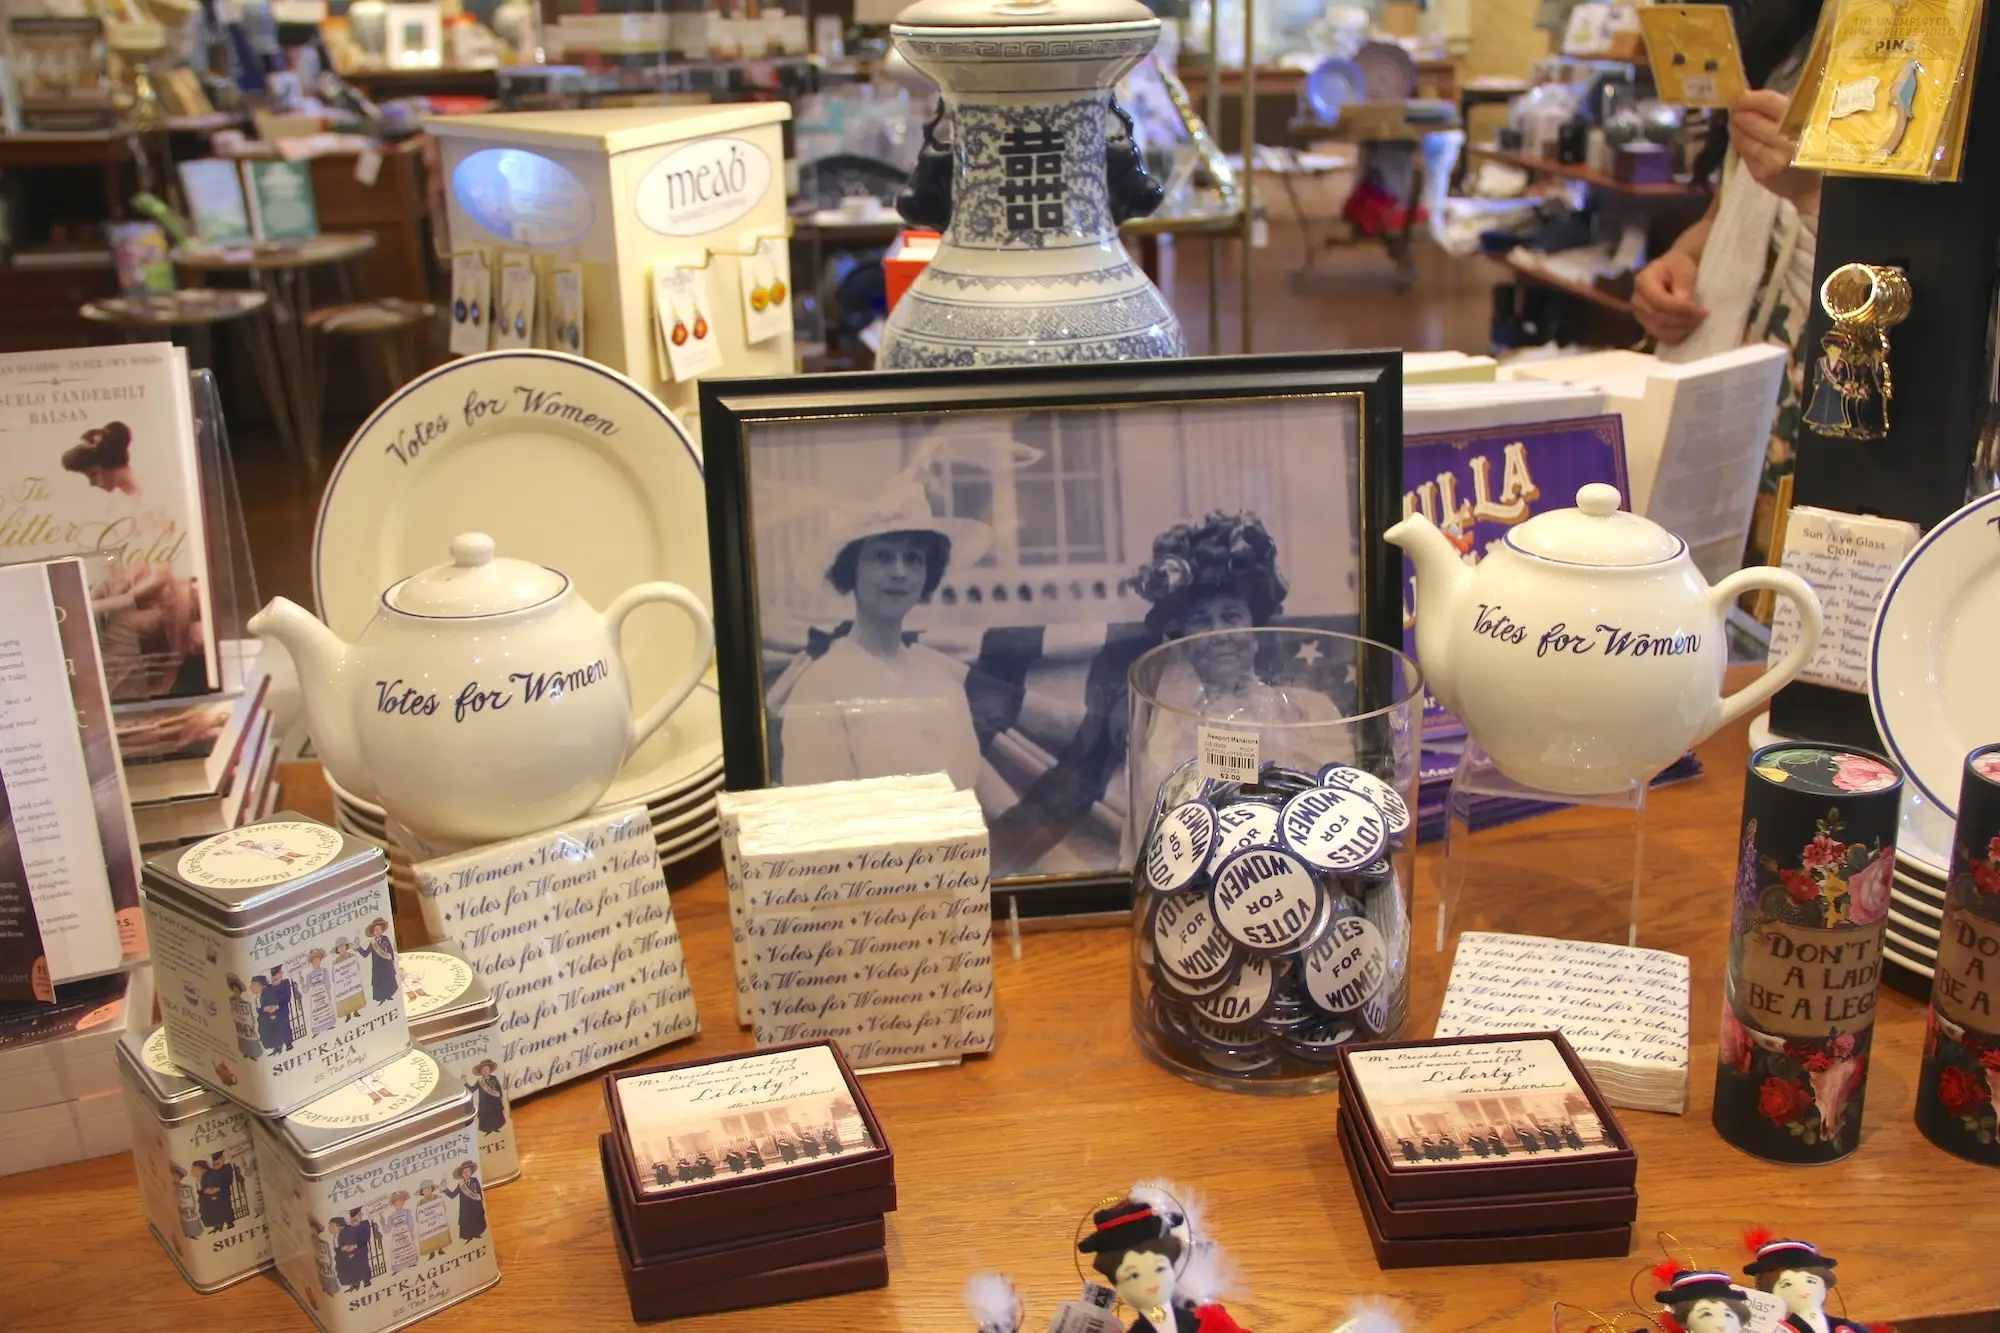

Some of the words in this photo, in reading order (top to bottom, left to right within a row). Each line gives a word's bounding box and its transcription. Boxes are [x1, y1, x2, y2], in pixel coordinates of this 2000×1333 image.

[1874, 39, 1917, 53] PINS
[51, 385, 147, 405] VANDERBILT
[29, 409, 89, 426] BALSAN
[386, 413, 449, 467] Votes
[462, 390, 508, 427] for
[513, 385, 621, 437] Women
[0, 507, 79, 548] litter
[1803, 528, 1824, 541] Sun
[1856, 537, 1887, 551] Glass
[1827, 545, 1859, 559] Cloth
[1473, 603, 1528, 645] Votes
[1537, 623, 1596, 659] for
[1595, 624, 1702, 658] Women
[376, 678, 440, 717] Votes
[453, 682, 514, 723] for
[509, 657, 609, 706] Women
[1207, 733, 1230, 742] Newport
[1220, 773, 1241, 781] $2.00
[1287, 790, 1347, 847] WOMEN
[1380, 785, 1406, 830] OMEN
[1175, 806, 1212, 864] WOMEN
[1320, 814, 1350, 843] FOR
[1327, 815, 1379, 865] VOTES
[304, 849, 331, 867] Tea
[1148, 833, 1175, 888] VOTES
[1168, 831, 1182, 861] FOR
[449, 865, 525, 891] Women
[762, 859, 841, 880] Women
[855, 851, 904, 872] Votes
[904, 847, 935, 875] for
[456, 895, 501, 921] Votes
[503, 885, 529, 917] for
[528, 873, 597, 899] Women
[609, 849, 650, 874] Votes
[763, 887, 809, 907] Votes
[811, 883, 841, 912] for
[840, 879, 919, 899] Women
[932, 870, 979, 890] Votes
[1218, 854, 1293, 911] WOMEN
[253, 920, 302, 950] Alison
[305, 889, 381, 927] Gardiner's
[465, 922, 539, 949] Women
[552, 896, 594, 923] Votes
[596, 887, 621, 918] for
[1245, 889, 1285, 916] FOR
[250, 942, 285, 962] TEA
[289, 901, 380, 947] COLLECTION
[1179, 911, 1207, 945] FOR
[1243, 897, 1311, 945] VOTES
[1178, 925, 1233, 976] WOME
[1310, 919, 1365, 974] VOTES
[1332, 946, 1363, 979] FOR
[1472, 945, 1516, 959] Votes
[1515, 950, 1544, 962] for
[1545, 951, 1619, 970] Women
[1633, 963, 1679, 979] Votes
[1766, 932, 1871, 964] DON'T
[1325, 947, 1385, 1010] WOMEN
[1783, 966, 1805, 989] A
[1822, 961, 1881, 990] LADY
[1965, 956, 1985, 982] A
[1750, 982, 1785, 1015] BE
[1791, 998, 1812, 1021] A
[1941, 967, 1966, 1005] BE
[1969, 989, 1990, 1017] A
[272, 1007, 399, 1077] SUFFRAGETTE
[321, 1043, 357, 1068] TEA
[428, 1033, 490, 1056] rdiner's
[1494, 1046, 1523, 1059] long
[769, 1055, 799, 1068] long
[777, 1064, 797, 1077] for
[1426, 1059, 1468, 1068] women
[1471, 1055, 1501, 1065] wait
[1503, 1054, 1523, 1067] for
[190, 1131, 226, 1149] TEA
[195, 1112, 245, 1136] Alison
[328, 1185, 366, 1204] TEA
[370, 1143, 469, 1190] COLLECTION
[332, 1161, 384, 1193] Alison
[388, 1132, 471, 1170] Gardiner's
[348, 1244, 487, 1312] SUFFRAGETTE
[401, 1278, 442, 1302] TEA
